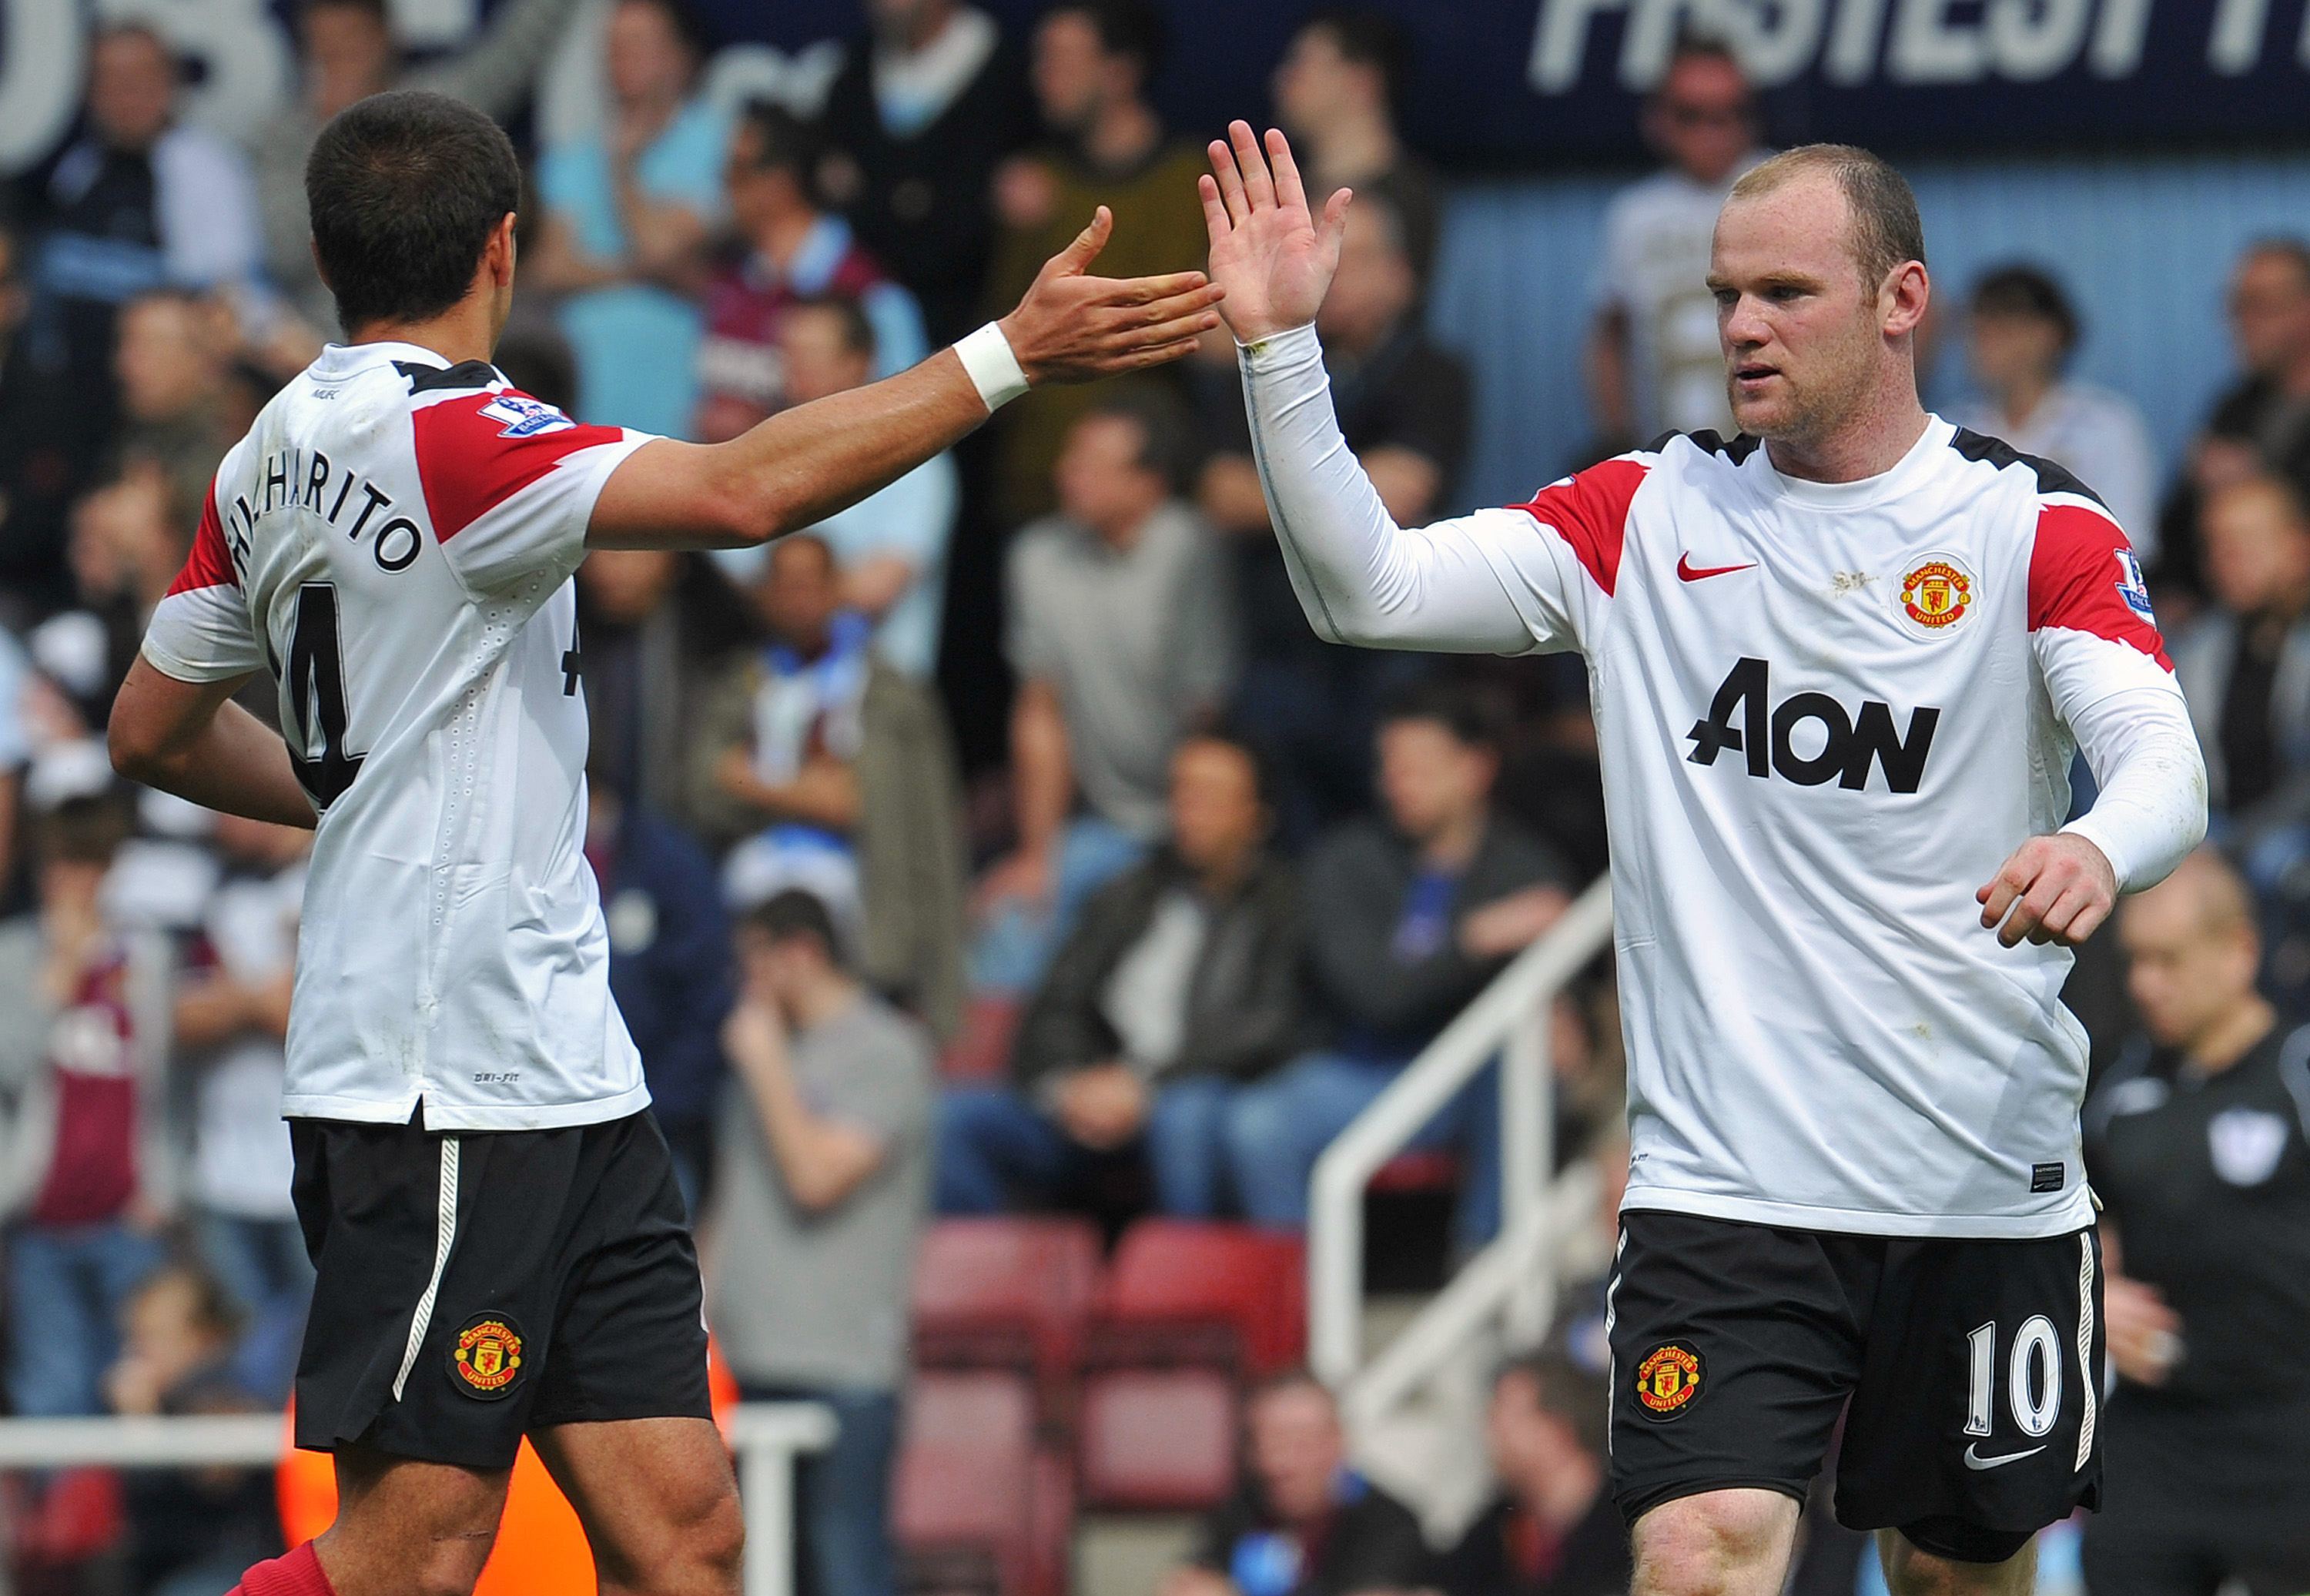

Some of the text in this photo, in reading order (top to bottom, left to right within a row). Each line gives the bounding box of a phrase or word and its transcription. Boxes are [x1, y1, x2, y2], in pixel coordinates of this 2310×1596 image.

[1907, 566, 1965, 588] MANCHESTER
[1914, 611, 1955, 624] UNITED
[1686, 657, 1942, 794] AON
[464, 1325, 517, 1351] MANCHESTER
[1642, 1350, 1693, 1375] MANCHESTER
[467, 1371, 506, 1386] UNITED
[1963, 1314, 2063, 1437] 10
[1649, 1393, 1685, 1407] UNITED
